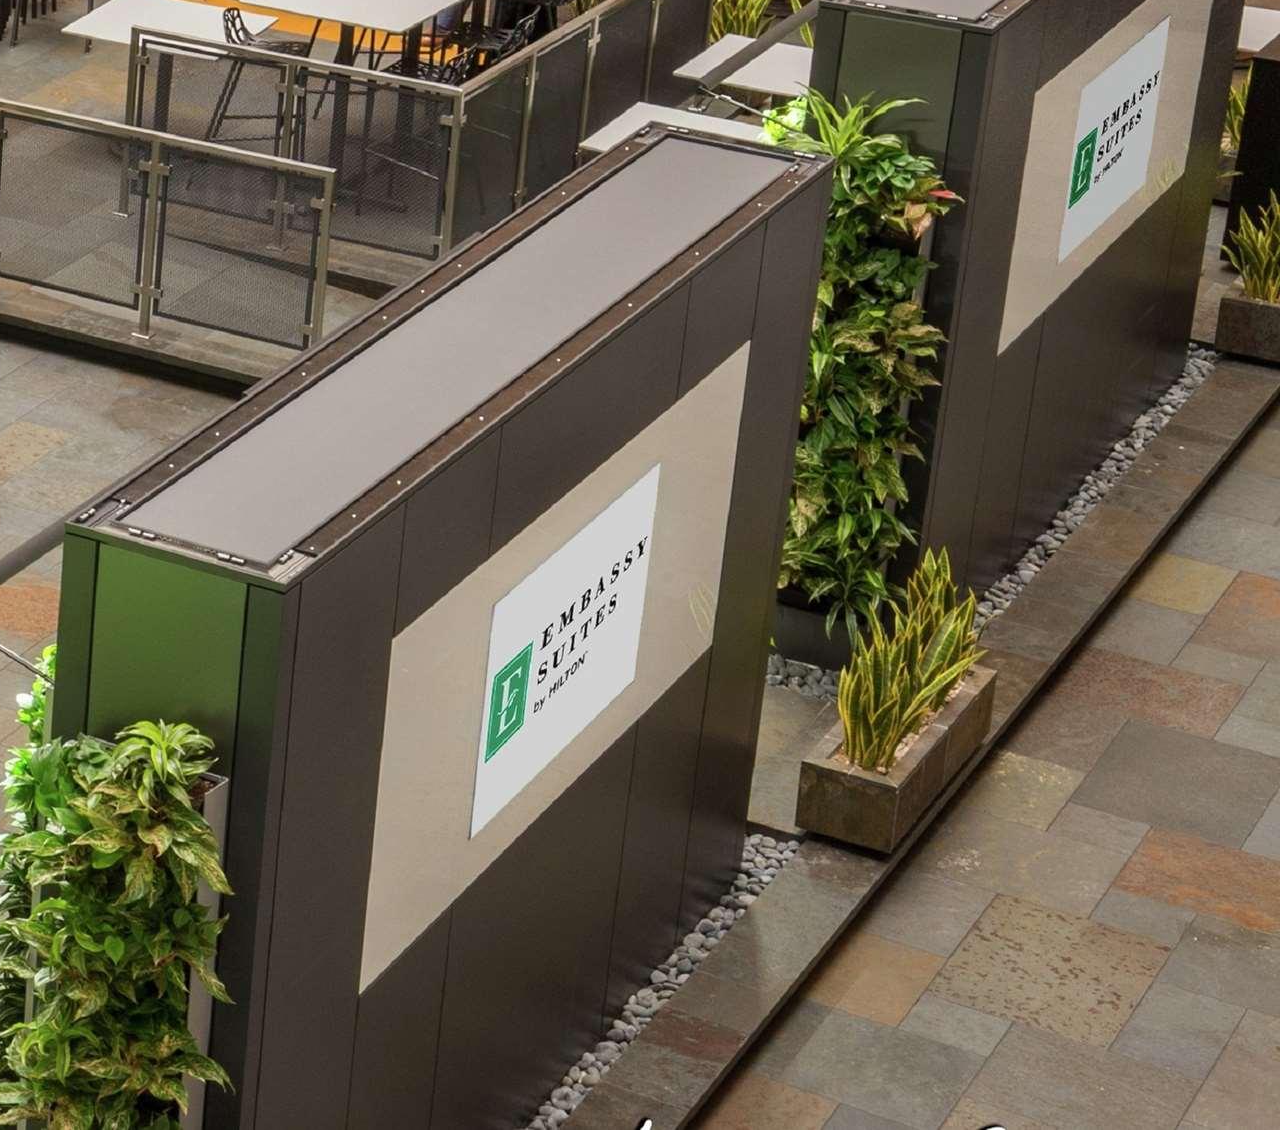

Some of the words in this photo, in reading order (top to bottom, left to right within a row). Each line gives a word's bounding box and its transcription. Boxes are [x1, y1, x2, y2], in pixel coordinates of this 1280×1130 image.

[1101, 70, 1160, 135] EMBASSY
[1096, 108, 1143, 163] SUITES
[539, 535, 649, 651] EMBASSY
[536, 592, 619, 685] SUITES
[533, 696, 546, 714] by
[548, 655, 587, 699] HILTON
